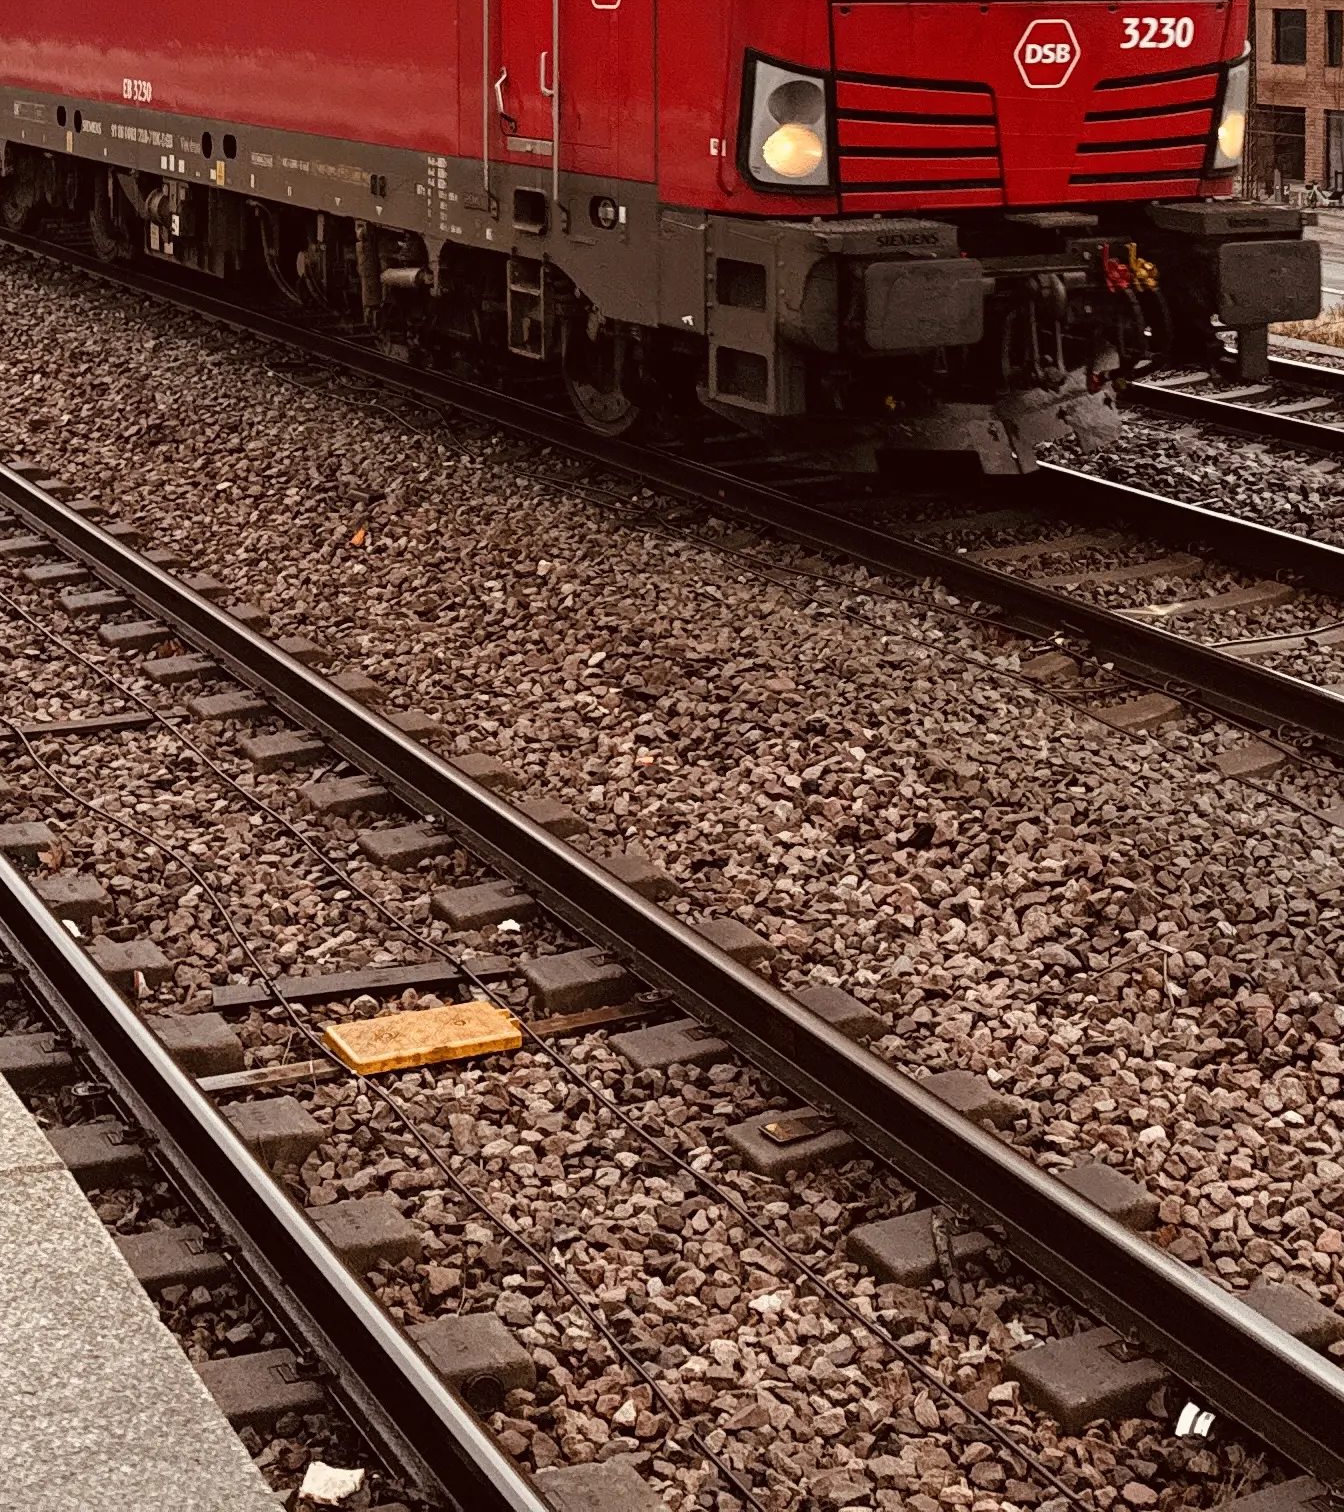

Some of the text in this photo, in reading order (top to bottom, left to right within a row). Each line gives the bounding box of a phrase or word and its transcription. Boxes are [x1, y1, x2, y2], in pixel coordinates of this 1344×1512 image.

[1119, 16, 1195, 50] 3230
[1024, 43, 1071, 65] DSB
[133, 79, 153, 104] 3230
[875, 231, 940, 248] SIEMENS
